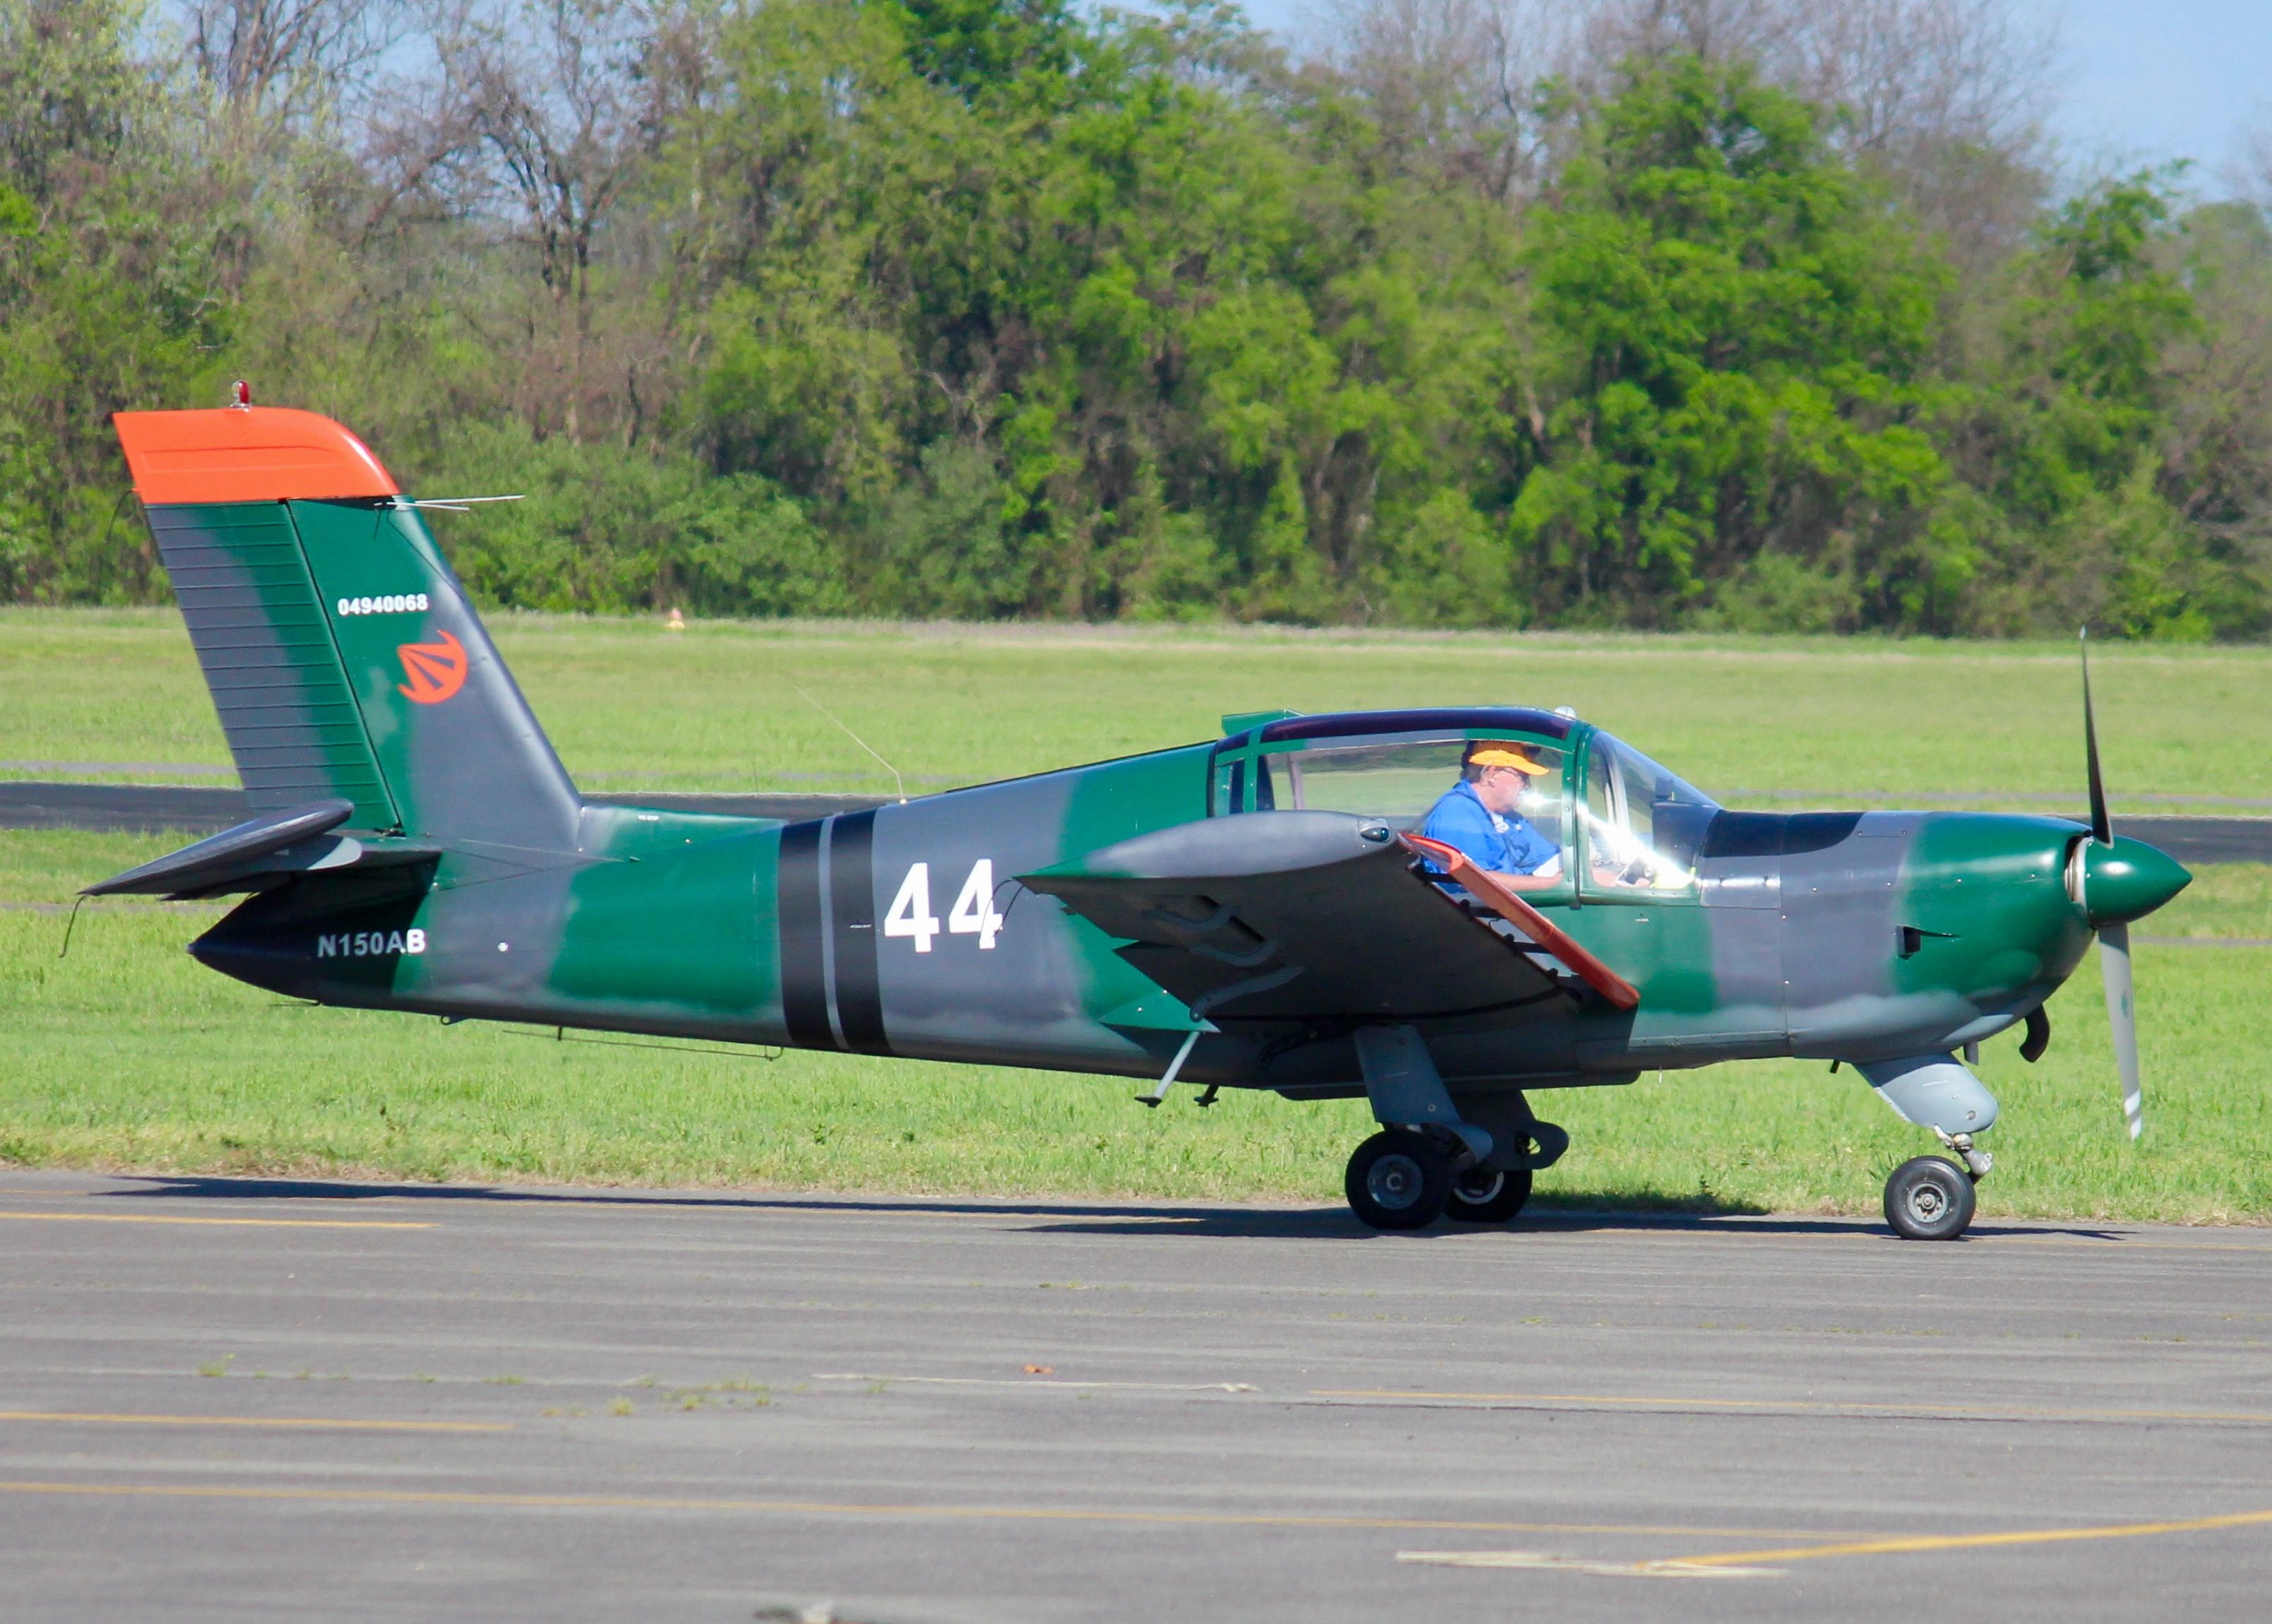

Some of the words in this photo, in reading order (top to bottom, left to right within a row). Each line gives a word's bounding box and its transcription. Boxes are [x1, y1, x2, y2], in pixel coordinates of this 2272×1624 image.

[338, 593, 429, 615] 04940068
[884, 858, 1002, 952] 44
[318, 928, 426, 957] N150AB
